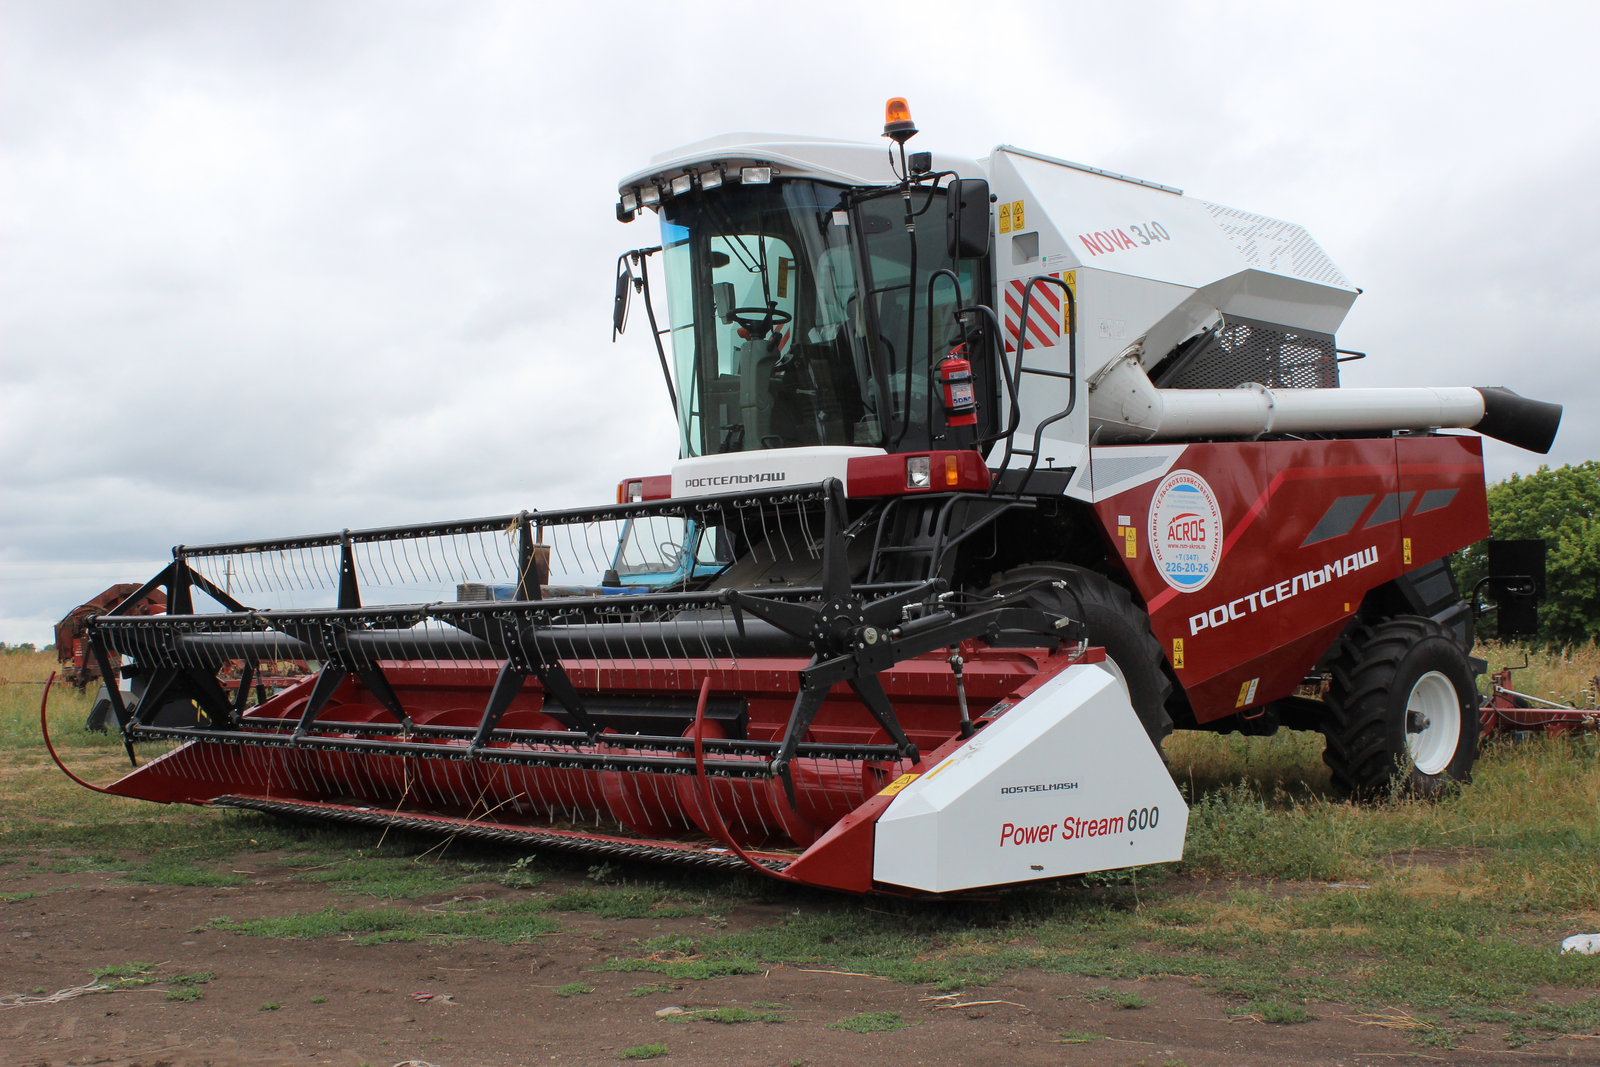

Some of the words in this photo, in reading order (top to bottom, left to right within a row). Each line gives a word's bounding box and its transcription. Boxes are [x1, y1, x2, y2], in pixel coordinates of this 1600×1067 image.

[1078, 228, 1139, 257] NOVA
[1130, 221, 1171, 246] 340
[685, 472, 786, 488] РОСТСЕЛЬМАШ
[1155, 476, 1217, 517] СЕЛЬСКОХОЗЯЙСТВЕННОЙ
[1152, 512, 1163, 561] ПОСТАВКА
[1167, 518, 1206, 542] ACROS
[1210, 520, 1219, 562] ТЕХНИКИ
[1165, 562, 1209, 573] 226-20-26
[1175, 553, 1183, 561] +7
[1183, 553, 1199, 562] (347)
[1188, 545, 1379, 636] РОСТСЕЛЬМАШ
[1001, 782, 1079, 794] ROSTSELMASH
[1000, 823, 1058, 847] Power
[1062, 816, 1124, 841] Stream
[1127, 806, 1159, 832] 600
